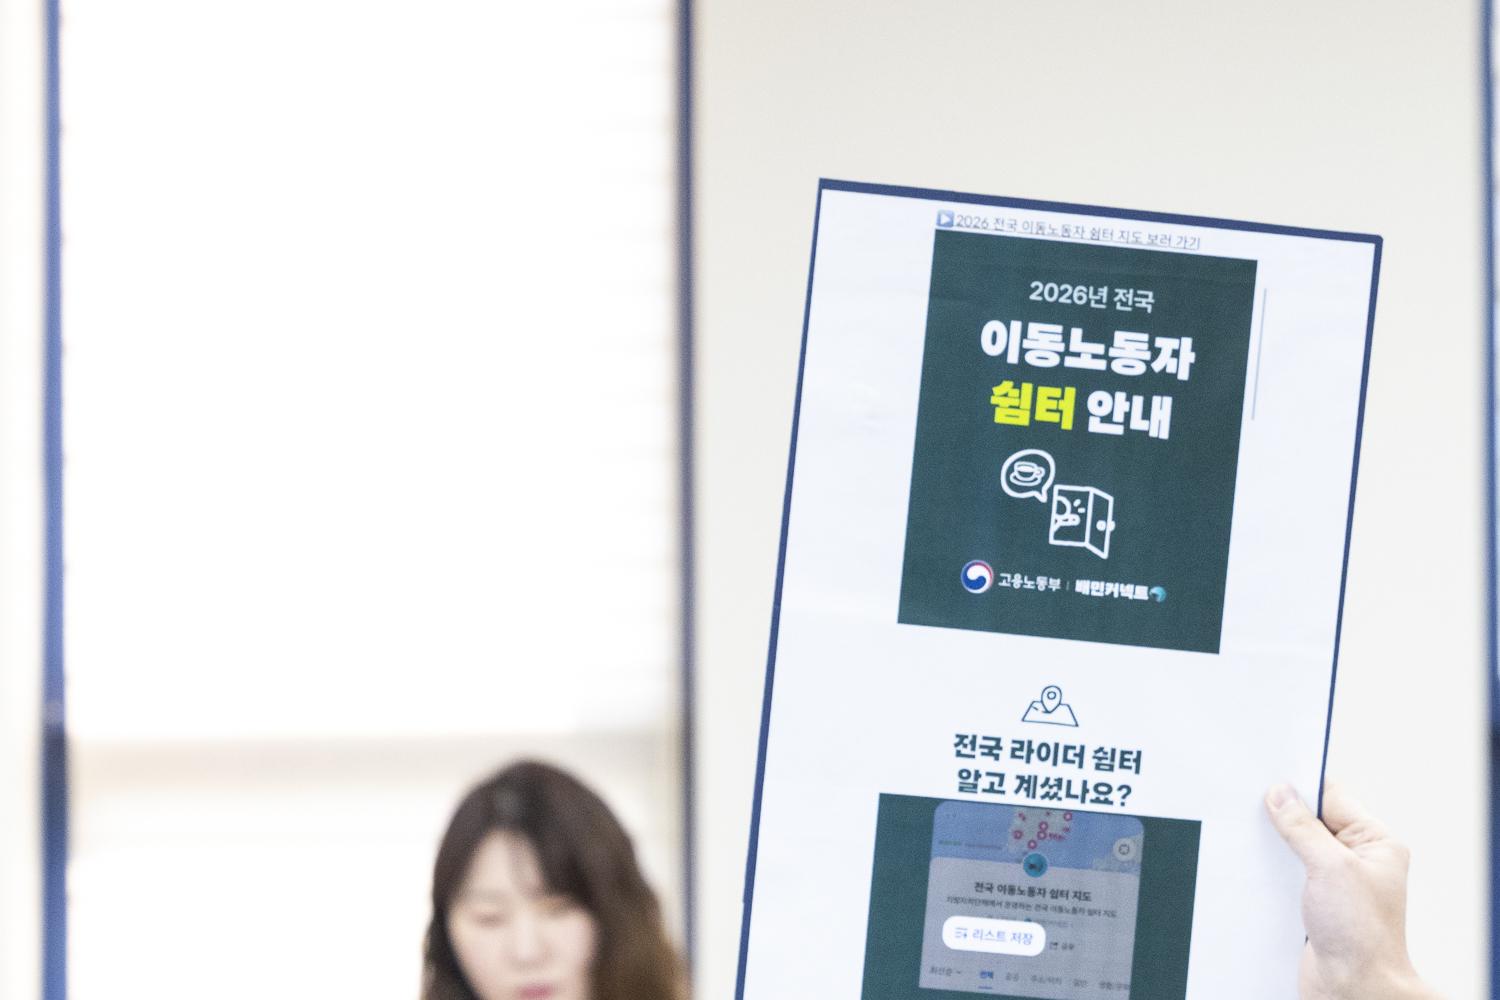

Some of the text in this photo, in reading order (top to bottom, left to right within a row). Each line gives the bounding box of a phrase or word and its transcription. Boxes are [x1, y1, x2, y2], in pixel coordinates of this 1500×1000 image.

[956, 214, 1201, 250] 2026 전국 이동노동자 쉼터 지도 보러 가기
[1029, 281, 1155, 314] 2026년 전국
[980, 319, 1196, 381] 이동노동자
[990, 380, 1173, 440] 쉼터 안내
[998, 572, 1150, 600] 고용노동부 배민커넥트
[953, 734, 1142, 775] 전국 라이더 쉼터
[957, 768, 1132, 807] 알고 계셨나요?
[997, 883, 1047, 899] 이동노동자
[972, 929, 1034, 946] 리스트 저장
